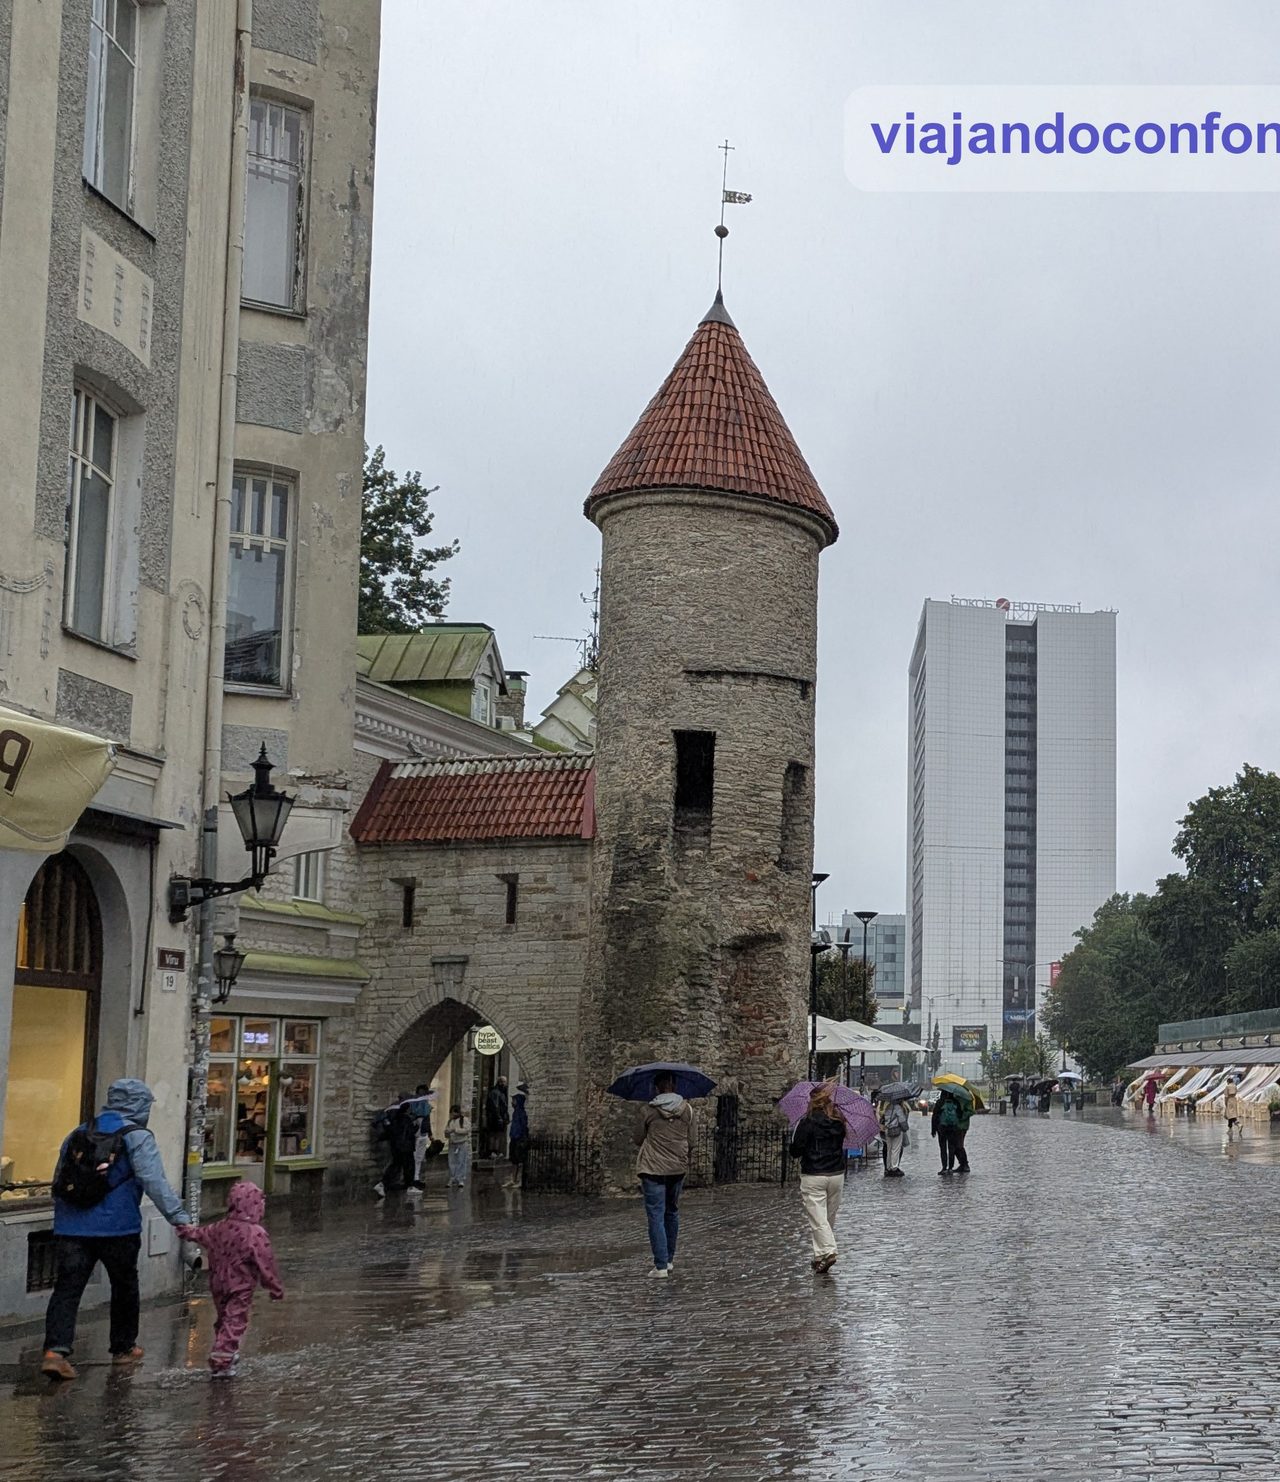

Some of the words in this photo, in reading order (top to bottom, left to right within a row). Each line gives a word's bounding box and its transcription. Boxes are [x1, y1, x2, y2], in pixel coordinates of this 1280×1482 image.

[951, 597, 994, 609] SOKOS
[1013, 601, 1048, 613] HOTEL
[1053, 604, 1081, 614] VIRU
[165, 953, 180, 966] Viru
[165, 975, 174, 988] 19
